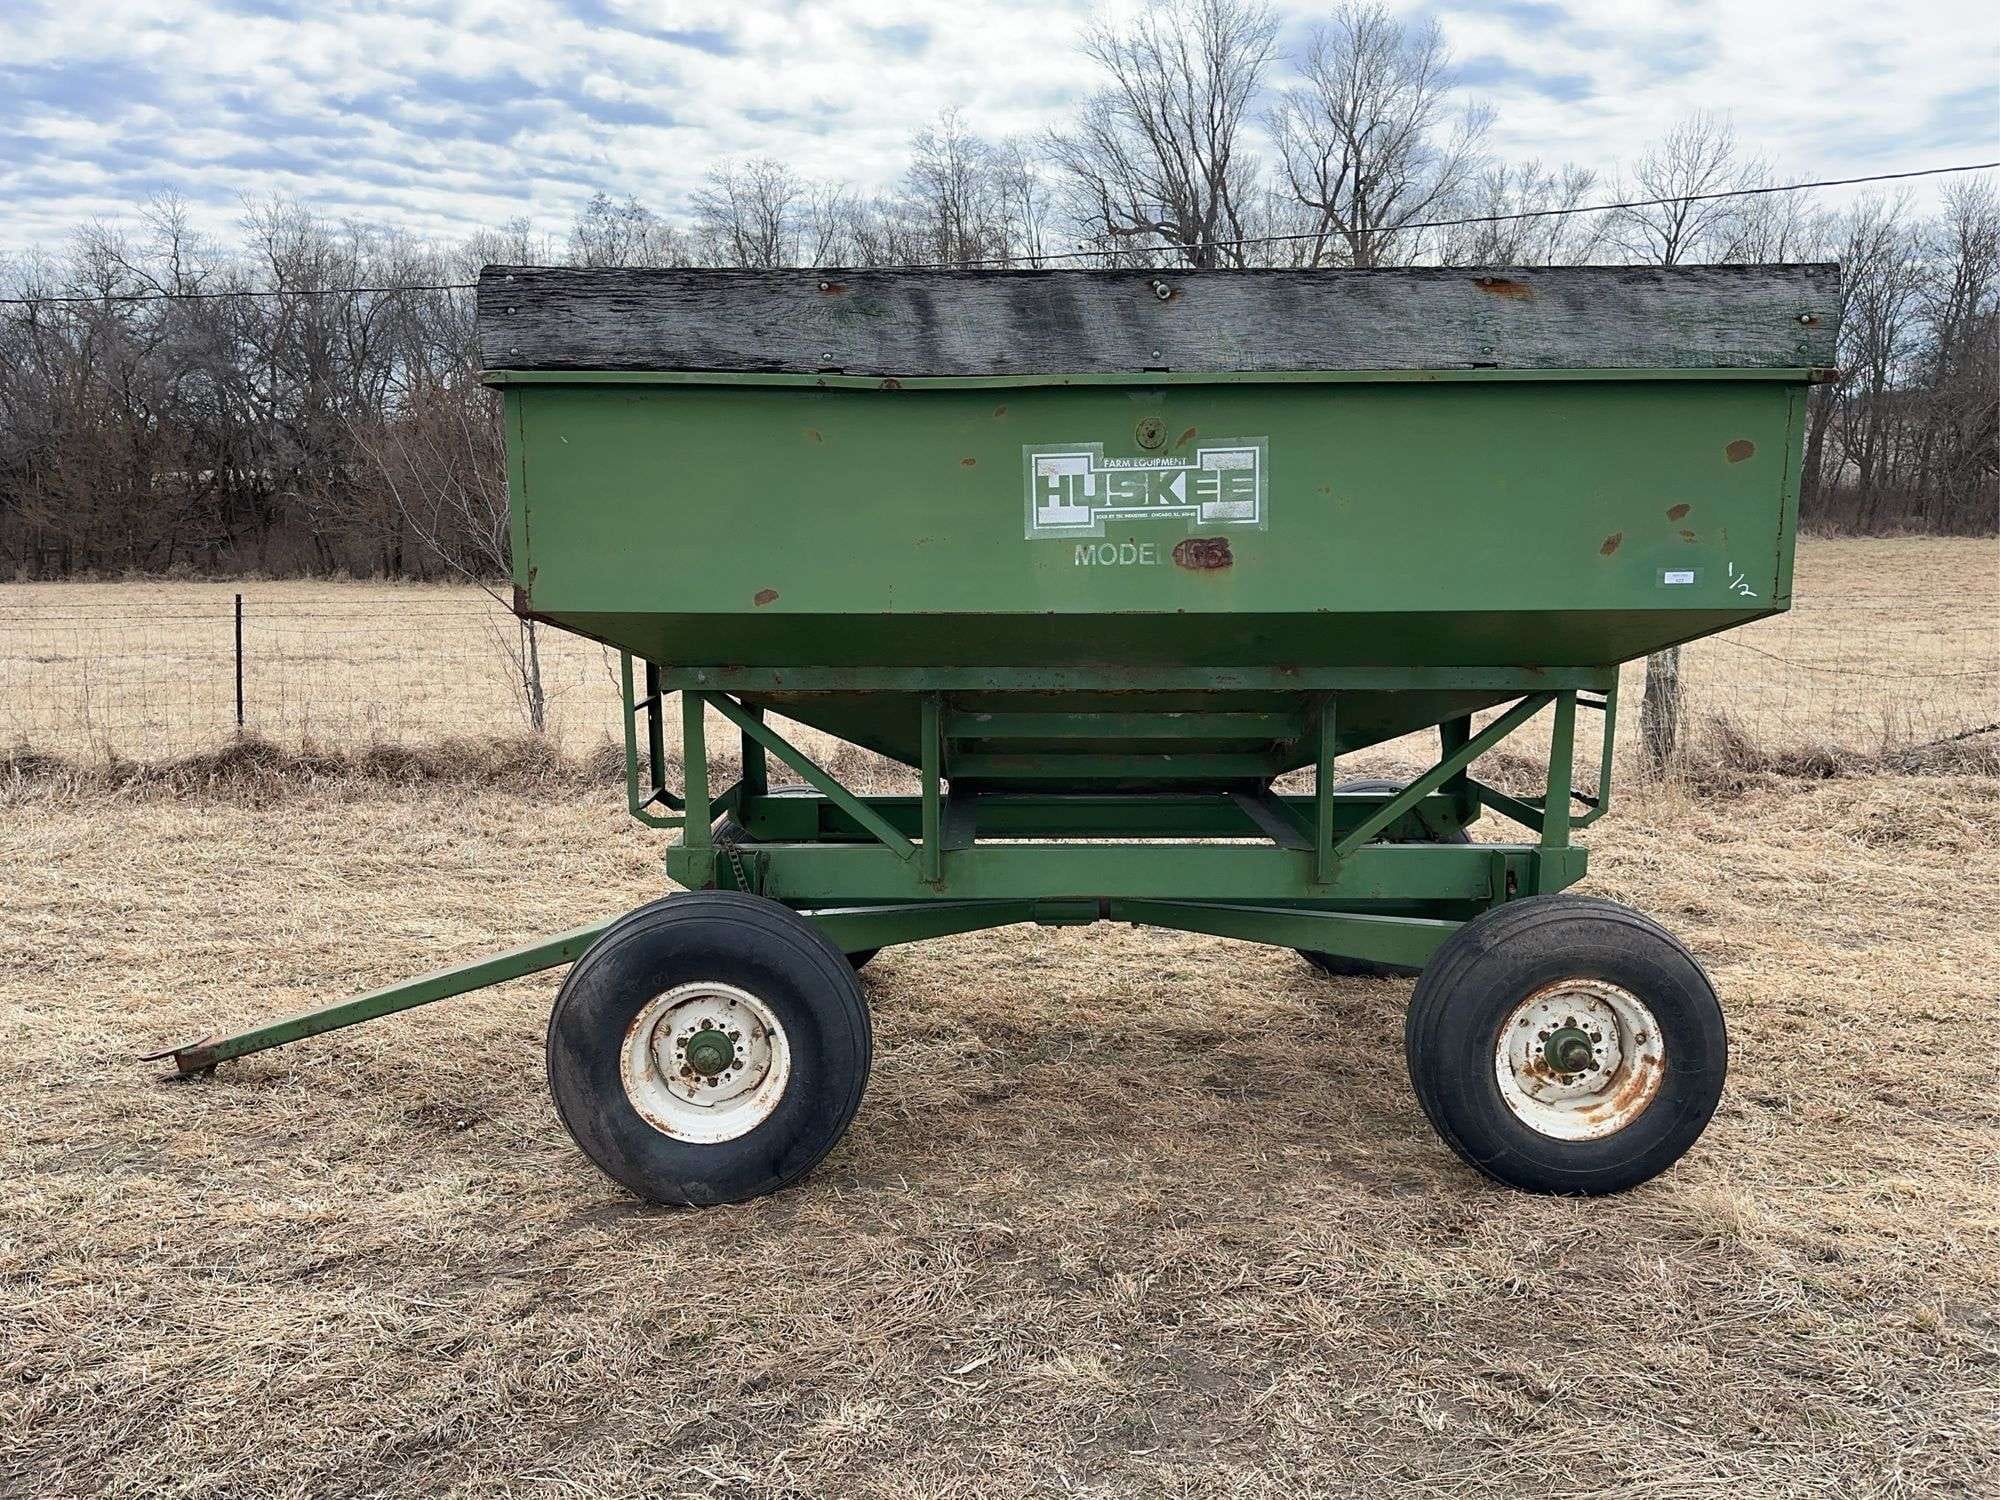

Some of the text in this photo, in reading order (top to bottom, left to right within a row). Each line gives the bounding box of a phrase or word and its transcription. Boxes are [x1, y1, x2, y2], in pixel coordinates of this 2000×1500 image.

[1104, 457, 1186, 468] FARM EQUIPMENT
[1037, 469, 1254, 508] HUSKEE
[1728, 561, 1758, 597] 1/2
